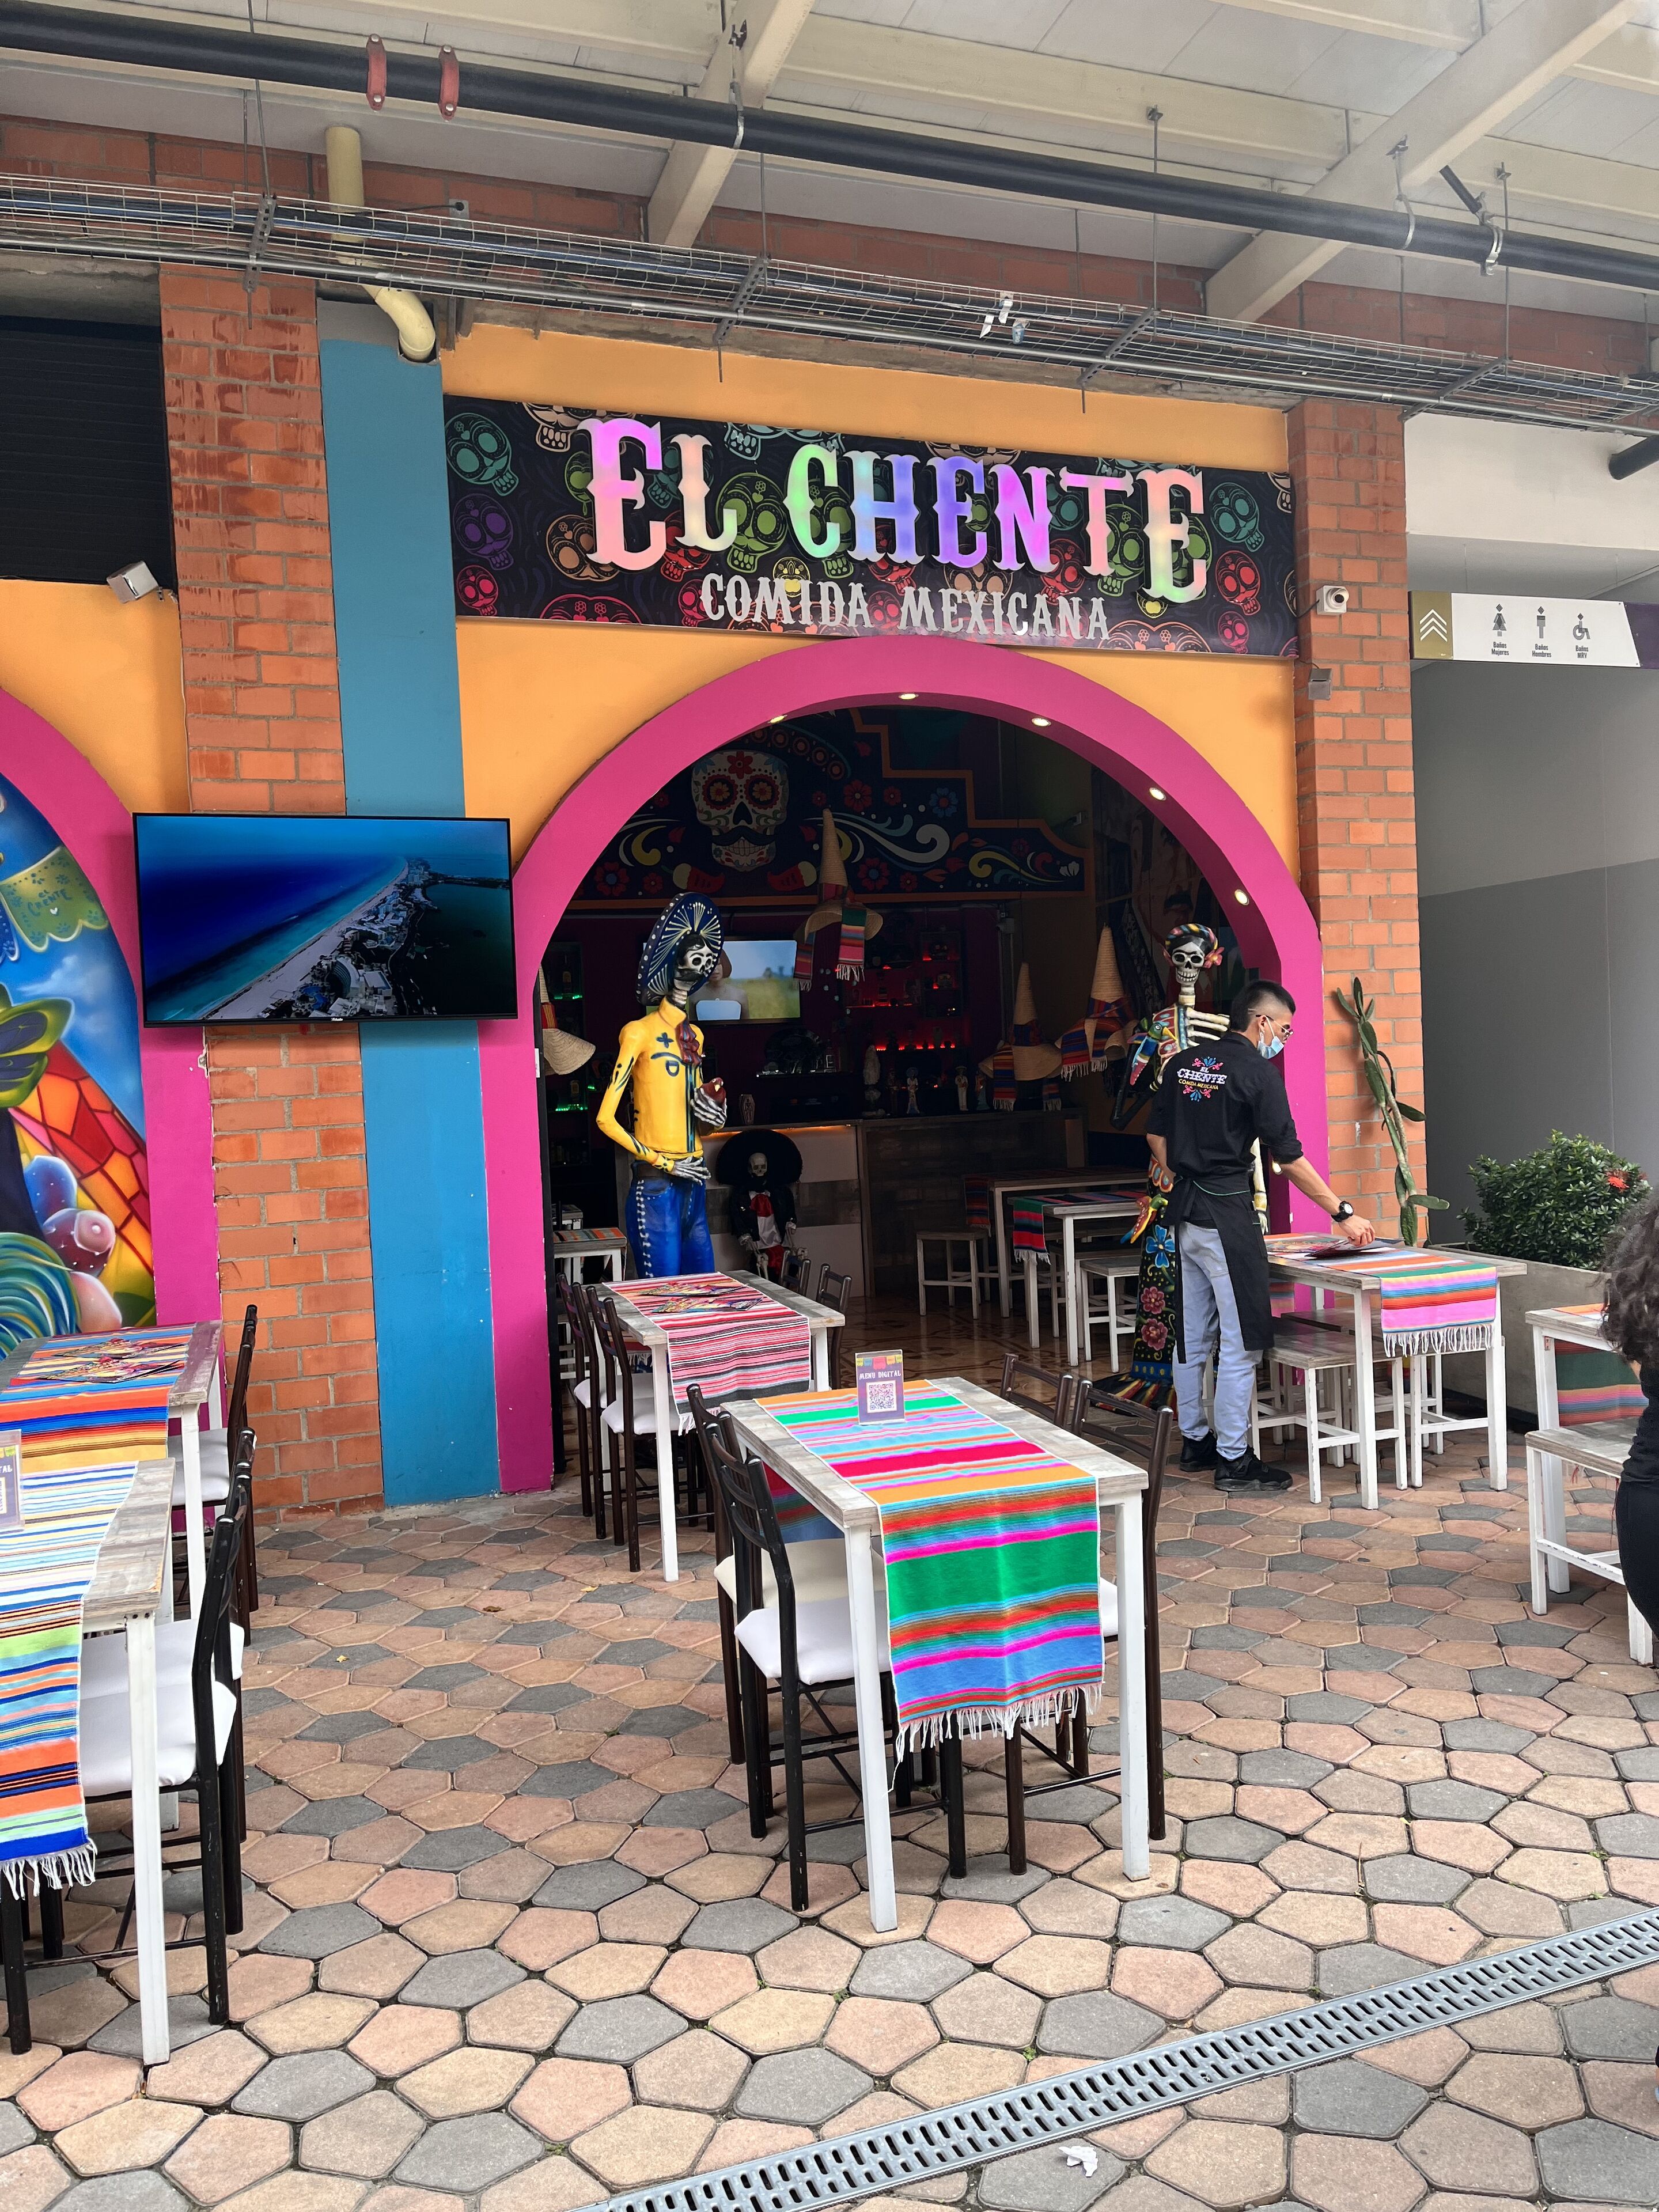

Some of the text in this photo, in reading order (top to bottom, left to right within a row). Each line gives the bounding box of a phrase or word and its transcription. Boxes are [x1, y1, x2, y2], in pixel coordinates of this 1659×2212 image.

[577, 418, 1207, 603] EL CHENTE
[700, 573, 1111, 640] COMIDA MEXICANA
[1177, 1069, 1228, 1085] CHENTE
[878, 1370, 902, 1378] DIGITAL
